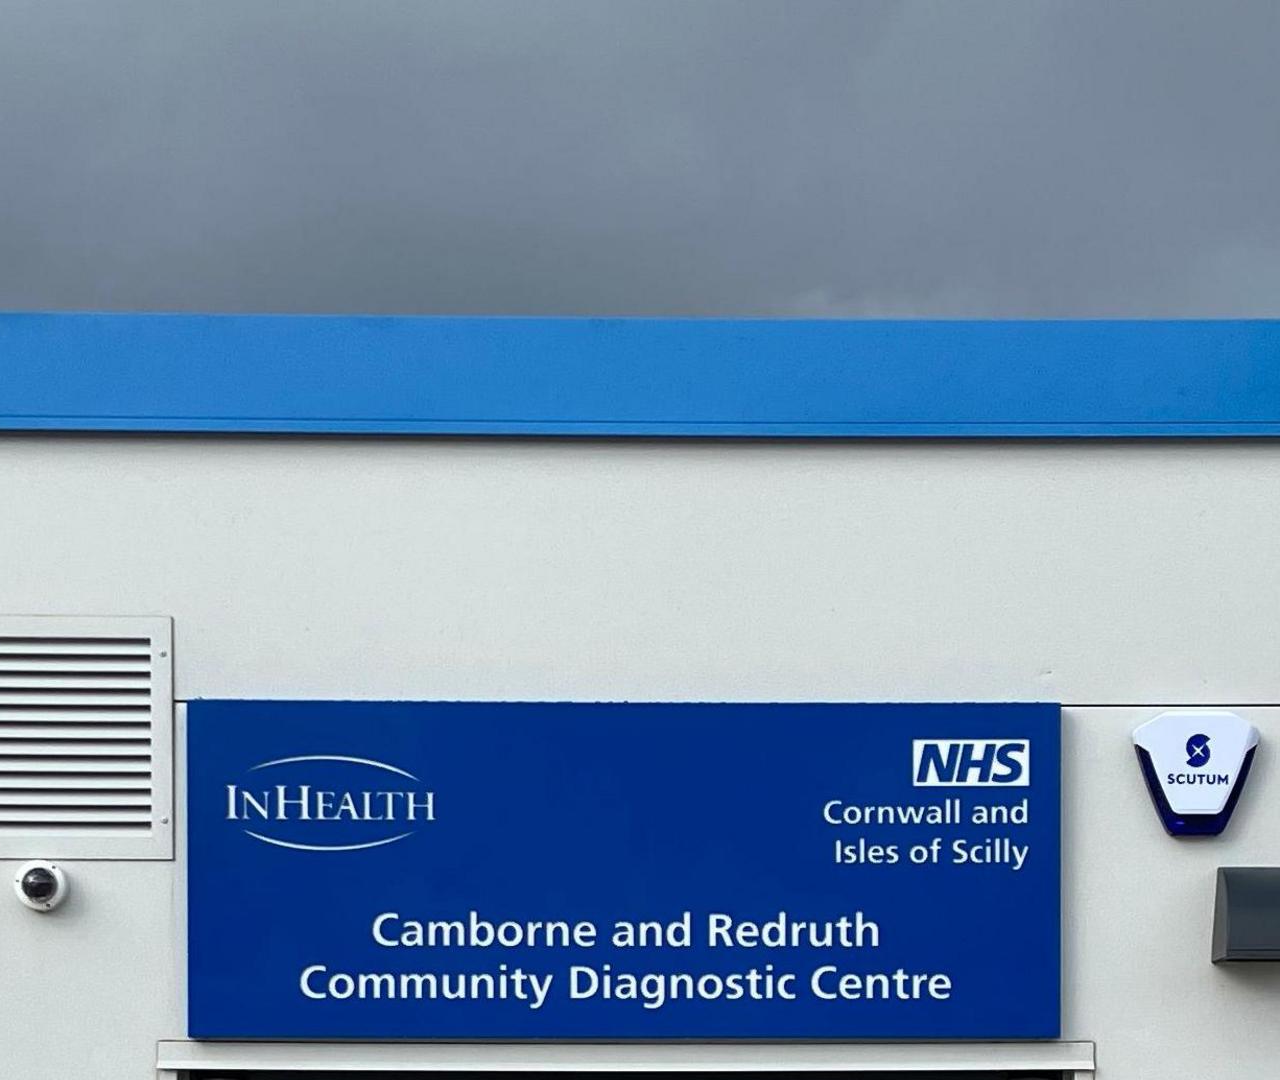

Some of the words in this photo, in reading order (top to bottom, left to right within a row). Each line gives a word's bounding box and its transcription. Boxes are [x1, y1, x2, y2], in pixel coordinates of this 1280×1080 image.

[916, 742, 1026, 783] NHS
[1167, 773, 1230, 786] SCUTUM
[823, 798, 960, 825] Cornwall
[972, 798, 1028, 824] and
[835, 838, 899, 864] Isles
[909, 837, 942, 864] of
[952, 838, 1029, 870] Scilly
[372, 911, 597, 947] Camborne
[612, 911, 691, 947] and
[709, 911, 879, 948] Redruth
[300, 964, 553, 1009] Community
[570, 964, 796, 1009] Diagnostic
[811, 965, 952, 1000] Centre
